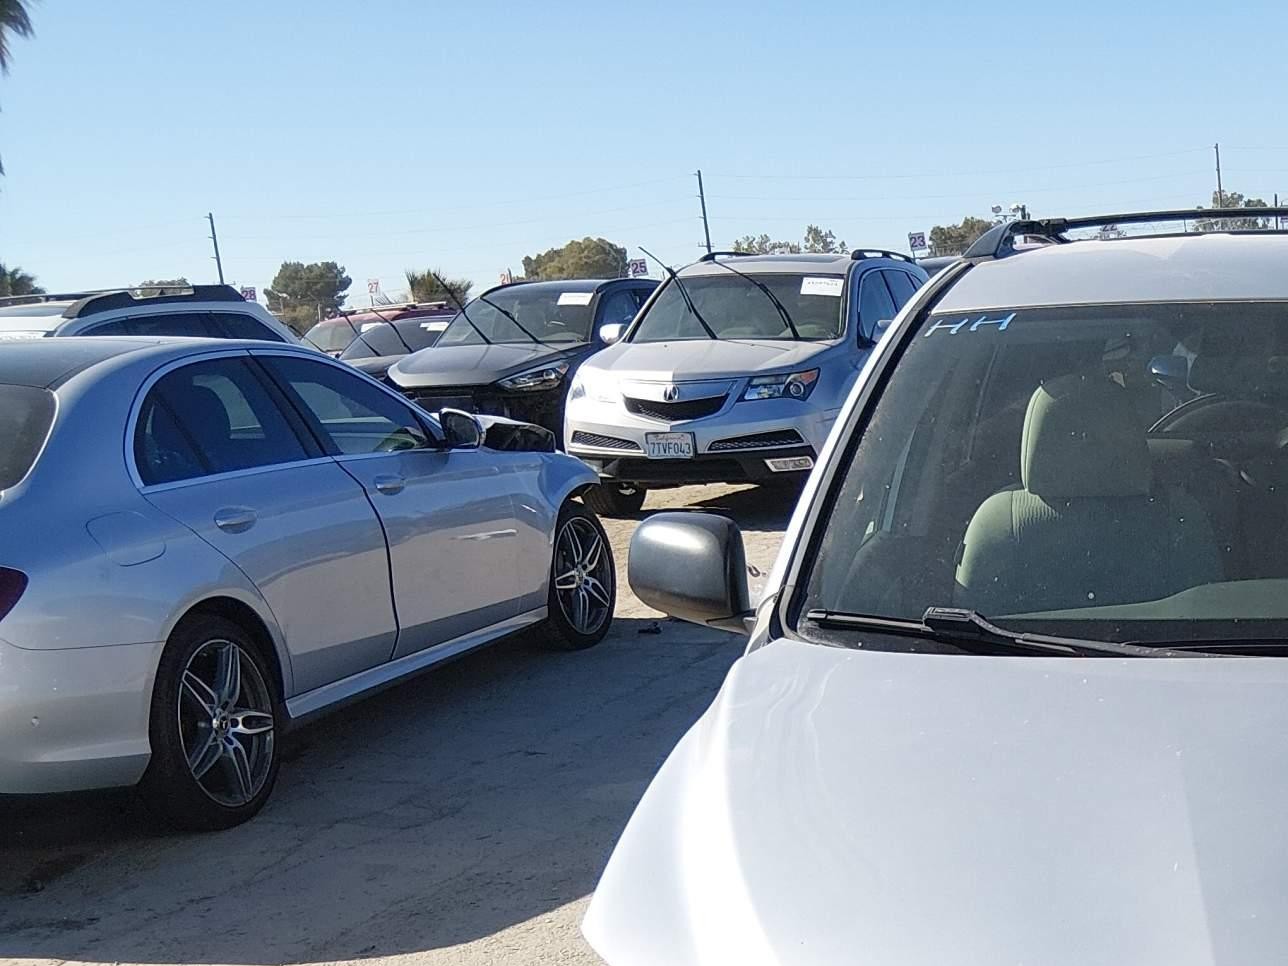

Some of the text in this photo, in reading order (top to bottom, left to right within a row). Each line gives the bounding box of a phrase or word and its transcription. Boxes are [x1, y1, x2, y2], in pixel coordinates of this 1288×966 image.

[911, 235, 926, 248] 23
[631, 261, 647, 274] 25
[368, 281, 379, 294] 27
[242, 289, 257, 300] 28
[650, 442, 692, 455] 7TVF043
